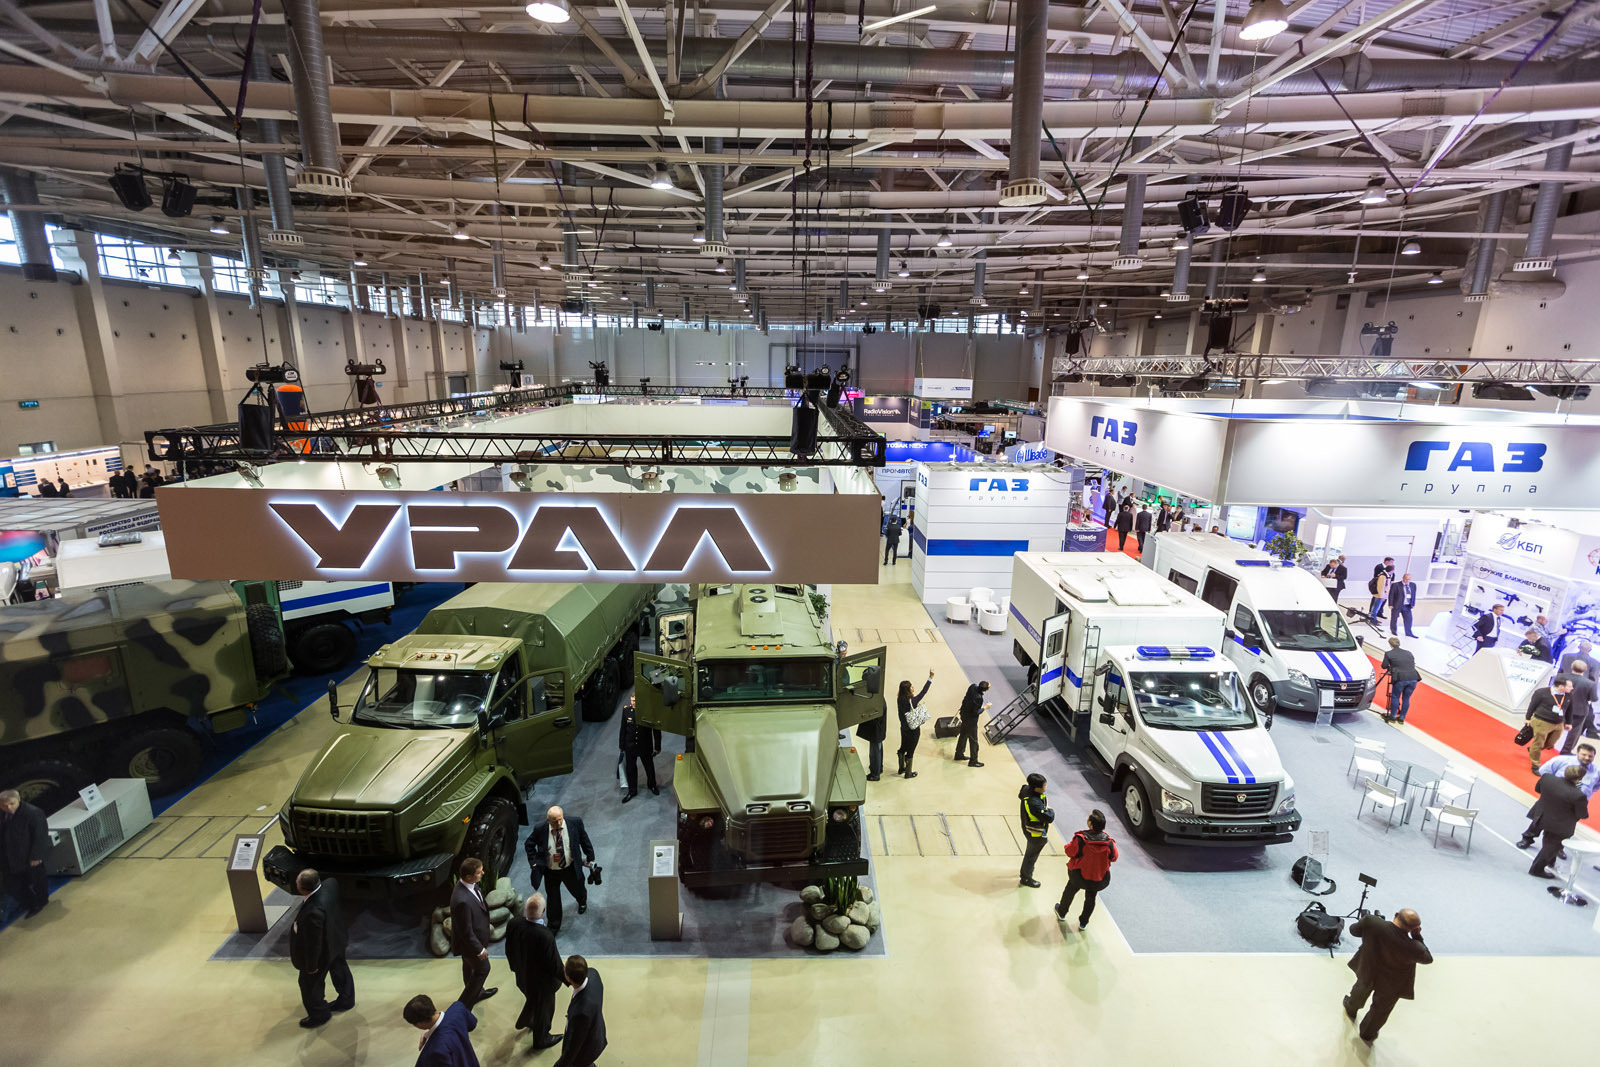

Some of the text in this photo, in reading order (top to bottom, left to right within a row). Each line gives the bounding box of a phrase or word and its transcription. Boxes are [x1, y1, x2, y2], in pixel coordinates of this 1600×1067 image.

[1090, 415, 1138, 447] ГАЗ
[1024, 448, 1048, 461] Швабе
[1088, 444, 1135, 464] группа
[1404, 440, 1548, 473] ГАЗ
[969, 478, 1030, 491] ГАЗ
[1400, 482, 1538, 495] группа
[88, 518, 131, 532] МИНИСТЕРСТВО
[99, 517, 160, 536] РОССИЙСКОЙ ФЕДЕРАЦ
[268, 503, 773, 572] УРАЛ
[1517, 540, 1543, 555] КБП
[1479, 566, 1551, 592] ОРУЖИЕ БЛИЖНЕГО БОЯ
